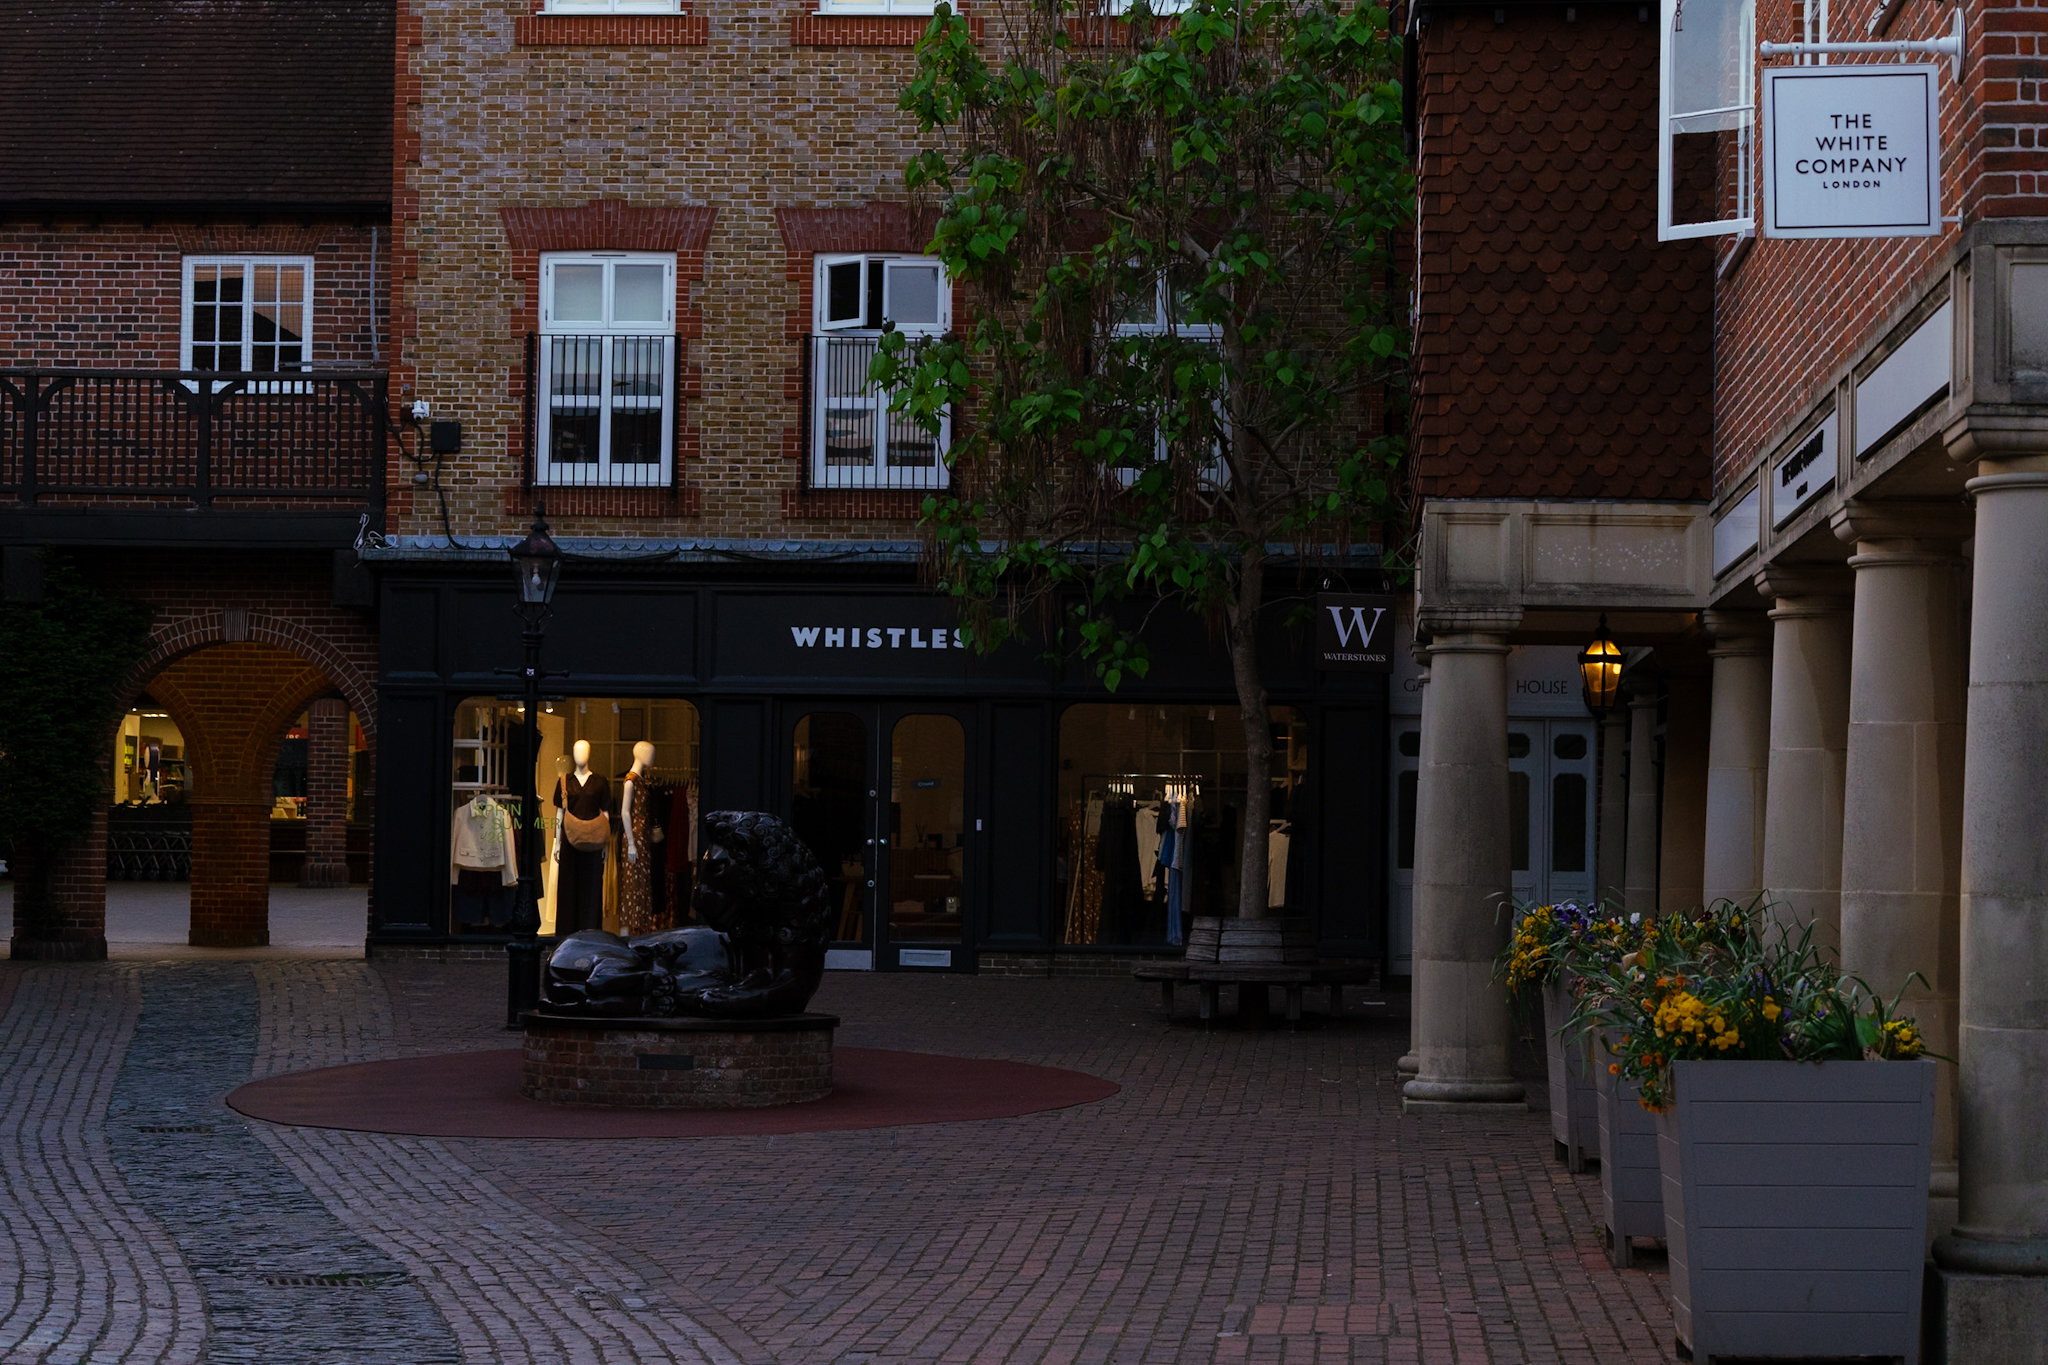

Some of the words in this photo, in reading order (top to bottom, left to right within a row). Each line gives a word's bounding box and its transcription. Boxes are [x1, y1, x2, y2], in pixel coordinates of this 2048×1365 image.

[1830, 114, 1872, 129] THE
[1815, 135, 1888, 151] WHITE
[1795, 157, 1907, 174] COMPANY
[1823, 180, 1881, 189] LONDON
[1325, 605, 1387, 648] W
[1323, 652, 1386, 662] WATERSTONES
[1516, 680, 1568, 694] HOUSE
[474, 803, 522, 818] SPRIN
